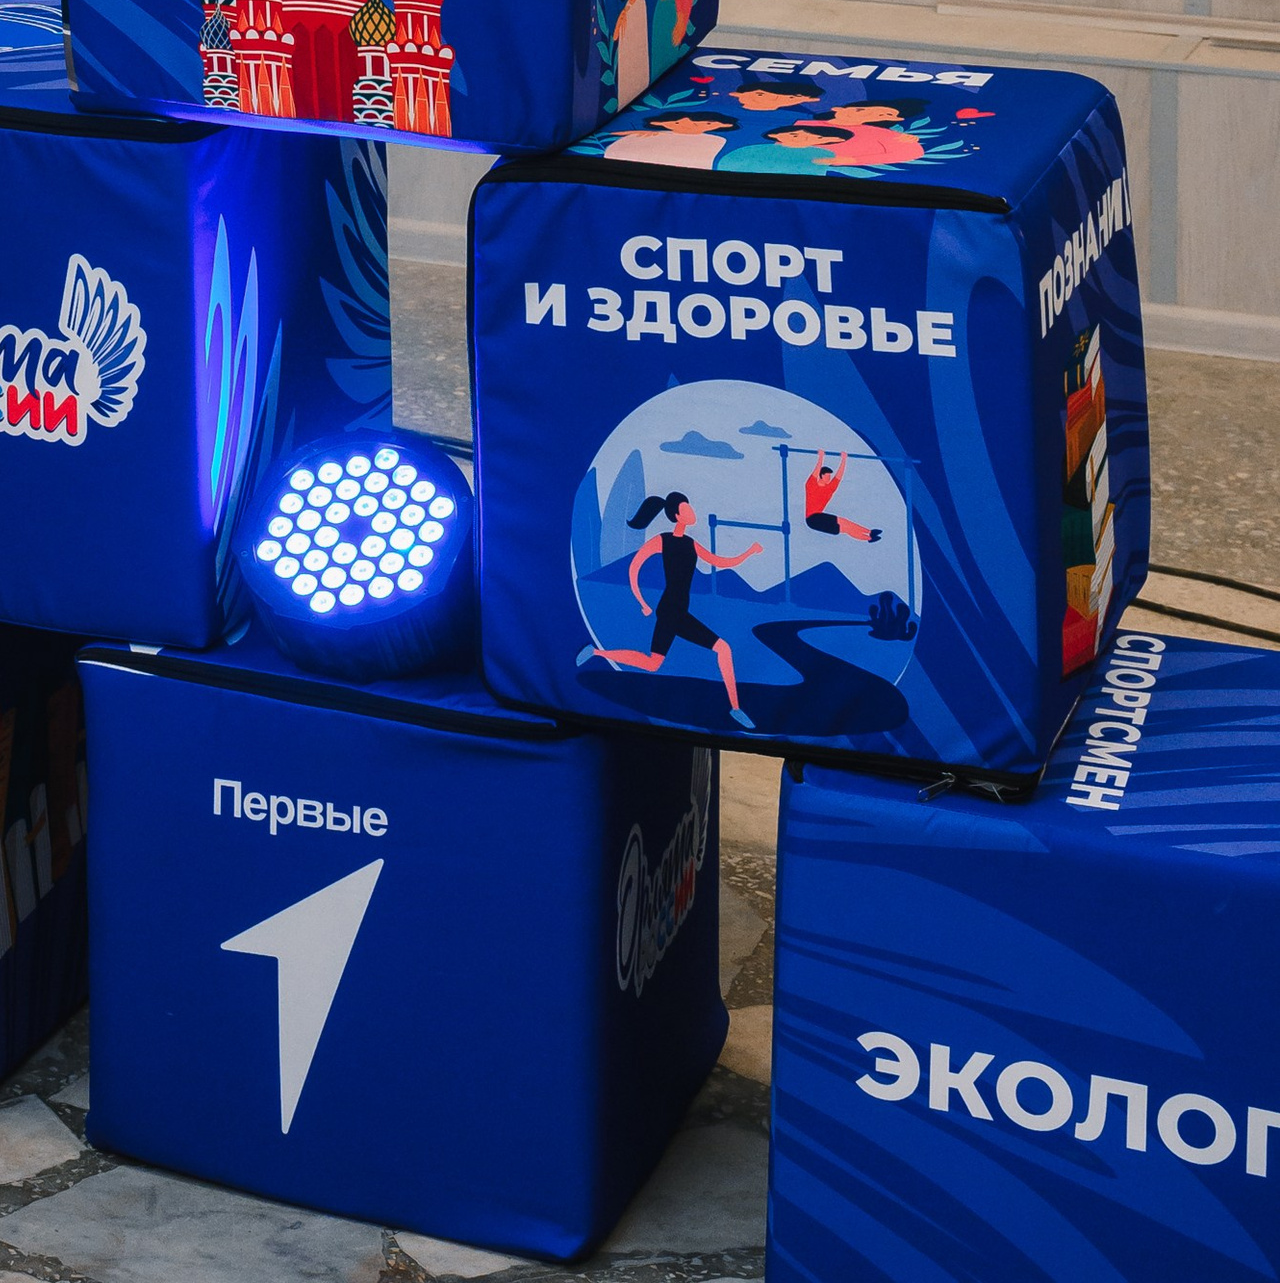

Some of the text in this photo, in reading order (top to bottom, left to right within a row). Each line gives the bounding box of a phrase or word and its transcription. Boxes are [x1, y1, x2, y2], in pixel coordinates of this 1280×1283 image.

[691, 53, 995, 88] СЕМЬЯ
[619, 234, 844, 294] СПОРТ
[524, 282, 958, 358] И ЗДОРОВЬЕ
[1065, 634, 1167, 812] СПОРТСМЕН
[212, 776, 389, 837] Первые
